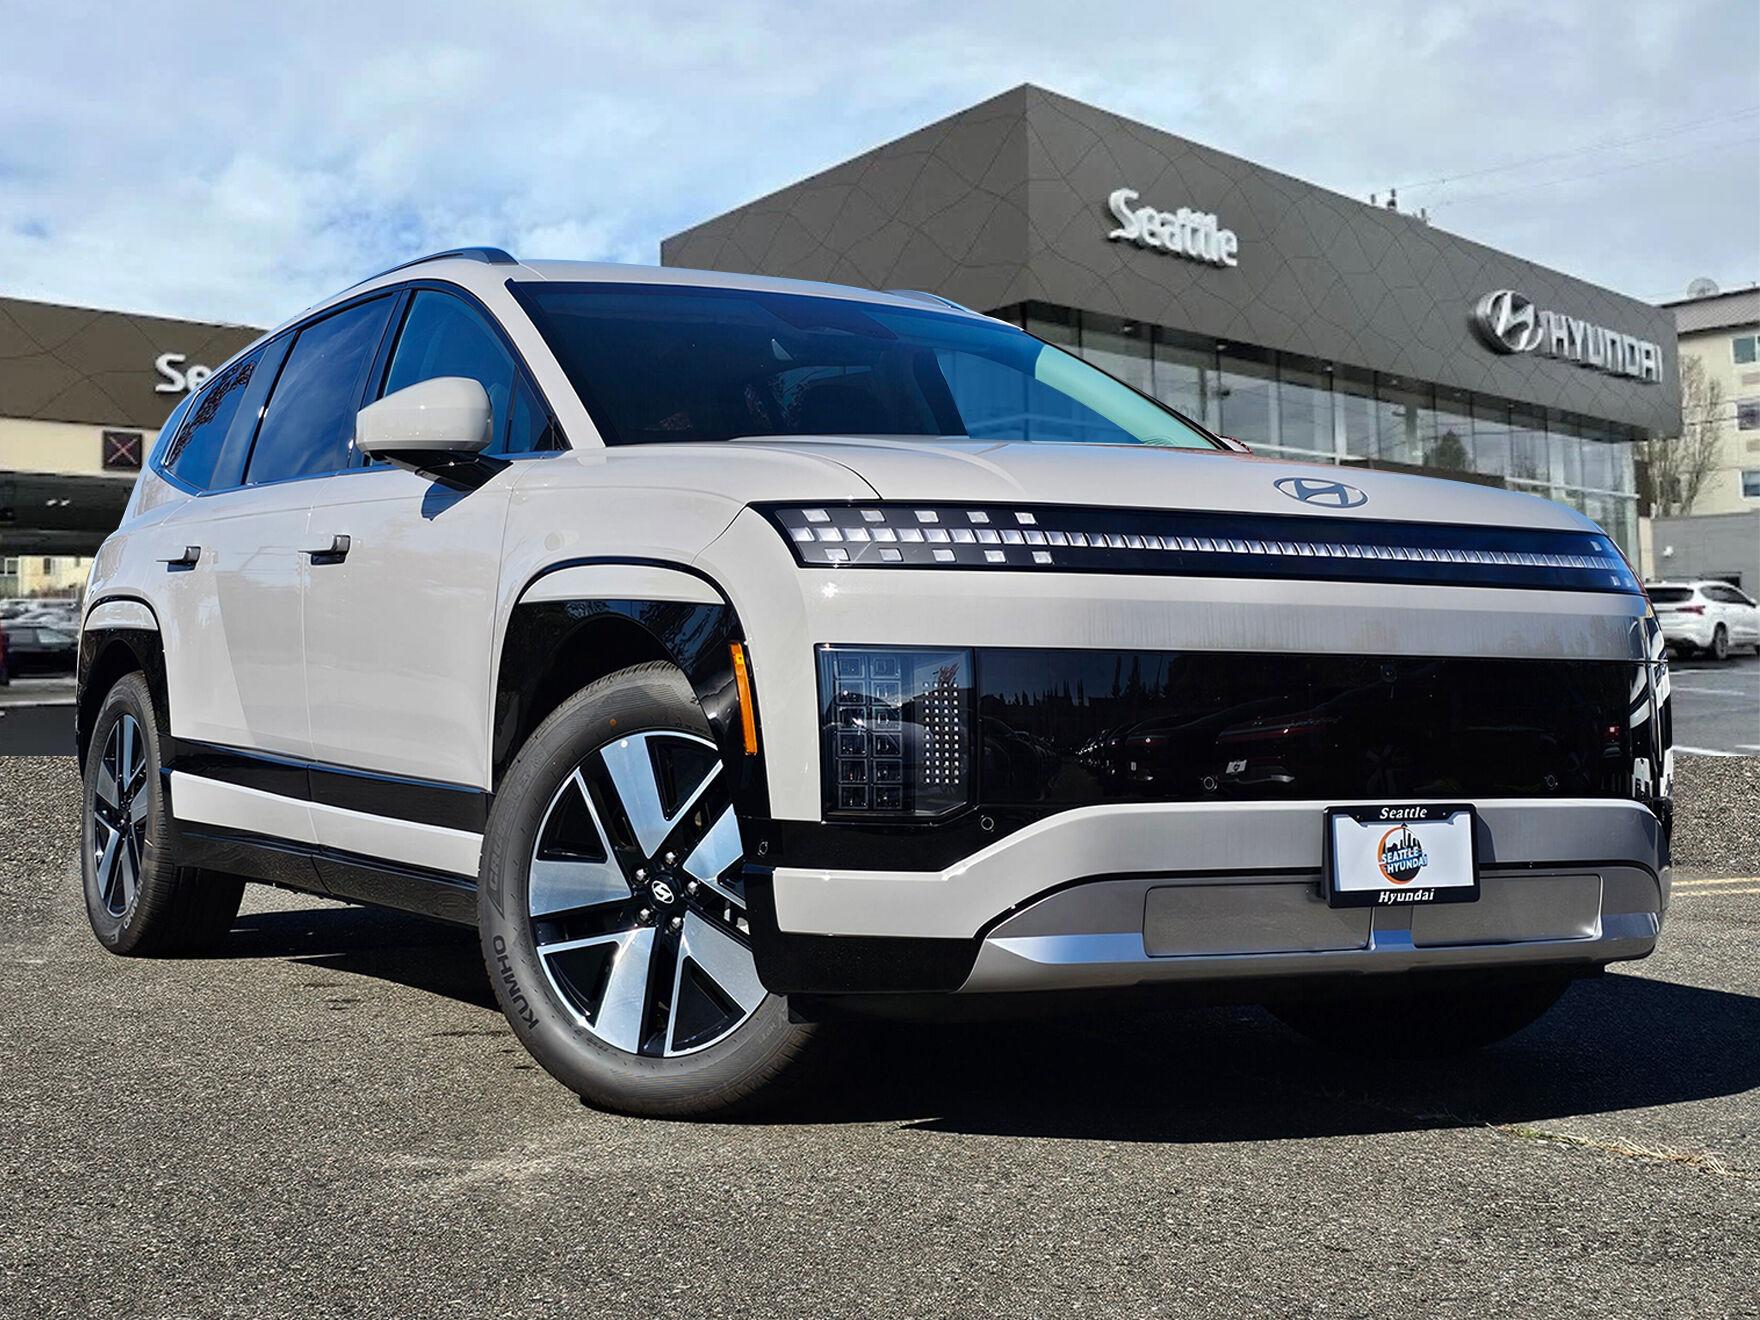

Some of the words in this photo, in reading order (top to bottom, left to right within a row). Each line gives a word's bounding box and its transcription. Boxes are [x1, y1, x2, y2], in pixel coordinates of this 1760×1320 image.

[1109, 188, 1237, 266] Seattle
[1540, 311, 1663, 383] HYUNDAI
[1380, 807, 1427, 819] Seattle
[1381, 846, 1420, 864] SEATTLE
[1387, 853, 1428, 874] HYUNDAI
[1378, 889, 1434, 904] Hyundai
[493, 935, 540, 1030] KUMHO
